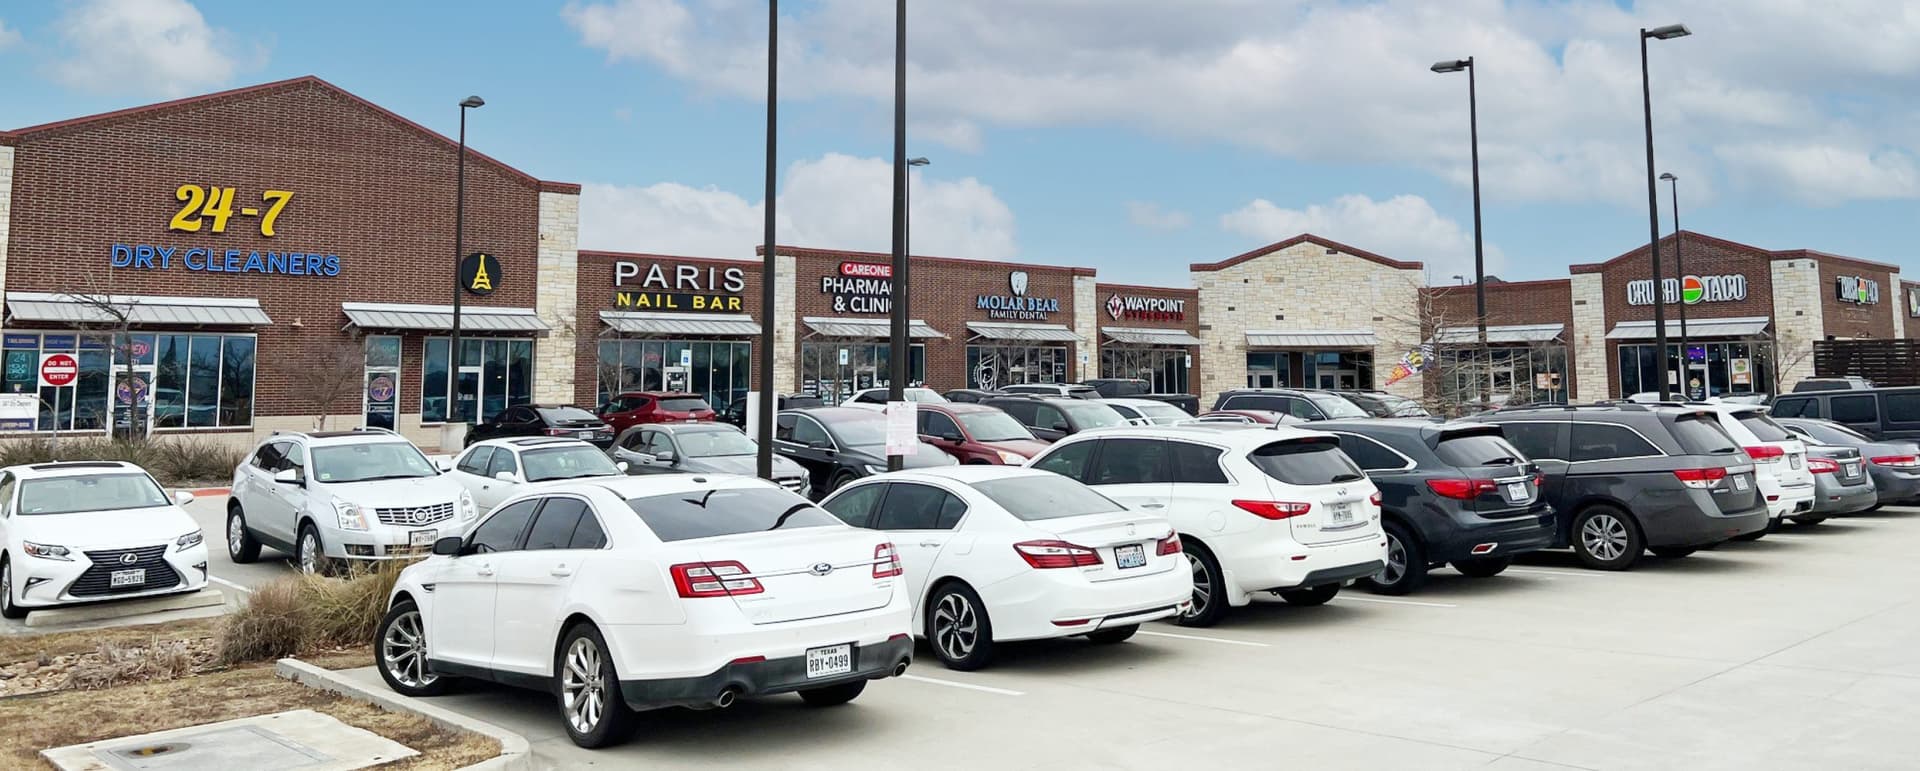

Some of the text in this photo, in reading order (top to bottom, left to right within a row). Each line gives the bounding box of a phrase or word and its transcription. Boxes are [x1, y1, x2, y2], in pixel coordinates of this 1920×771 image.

[169, 184, 294, 236] 24-7
[111, 243, 341, 276] DRY CLEANERS
[615, 261, 745, 292] PARIS
[844, 263, 892, 277] CAREONE
[1701, 274, 1747, 302] TACO
[617, 292, 741, 310] NAIL BAR
[834, 296, 892, 313] & CLINI
[977, 295, 1060, 312] MOLAR BEAR
[1124, 297, 1184, 312] WAYPOINT
[990, 309, 1048, 321] FAMILY DENTAL
